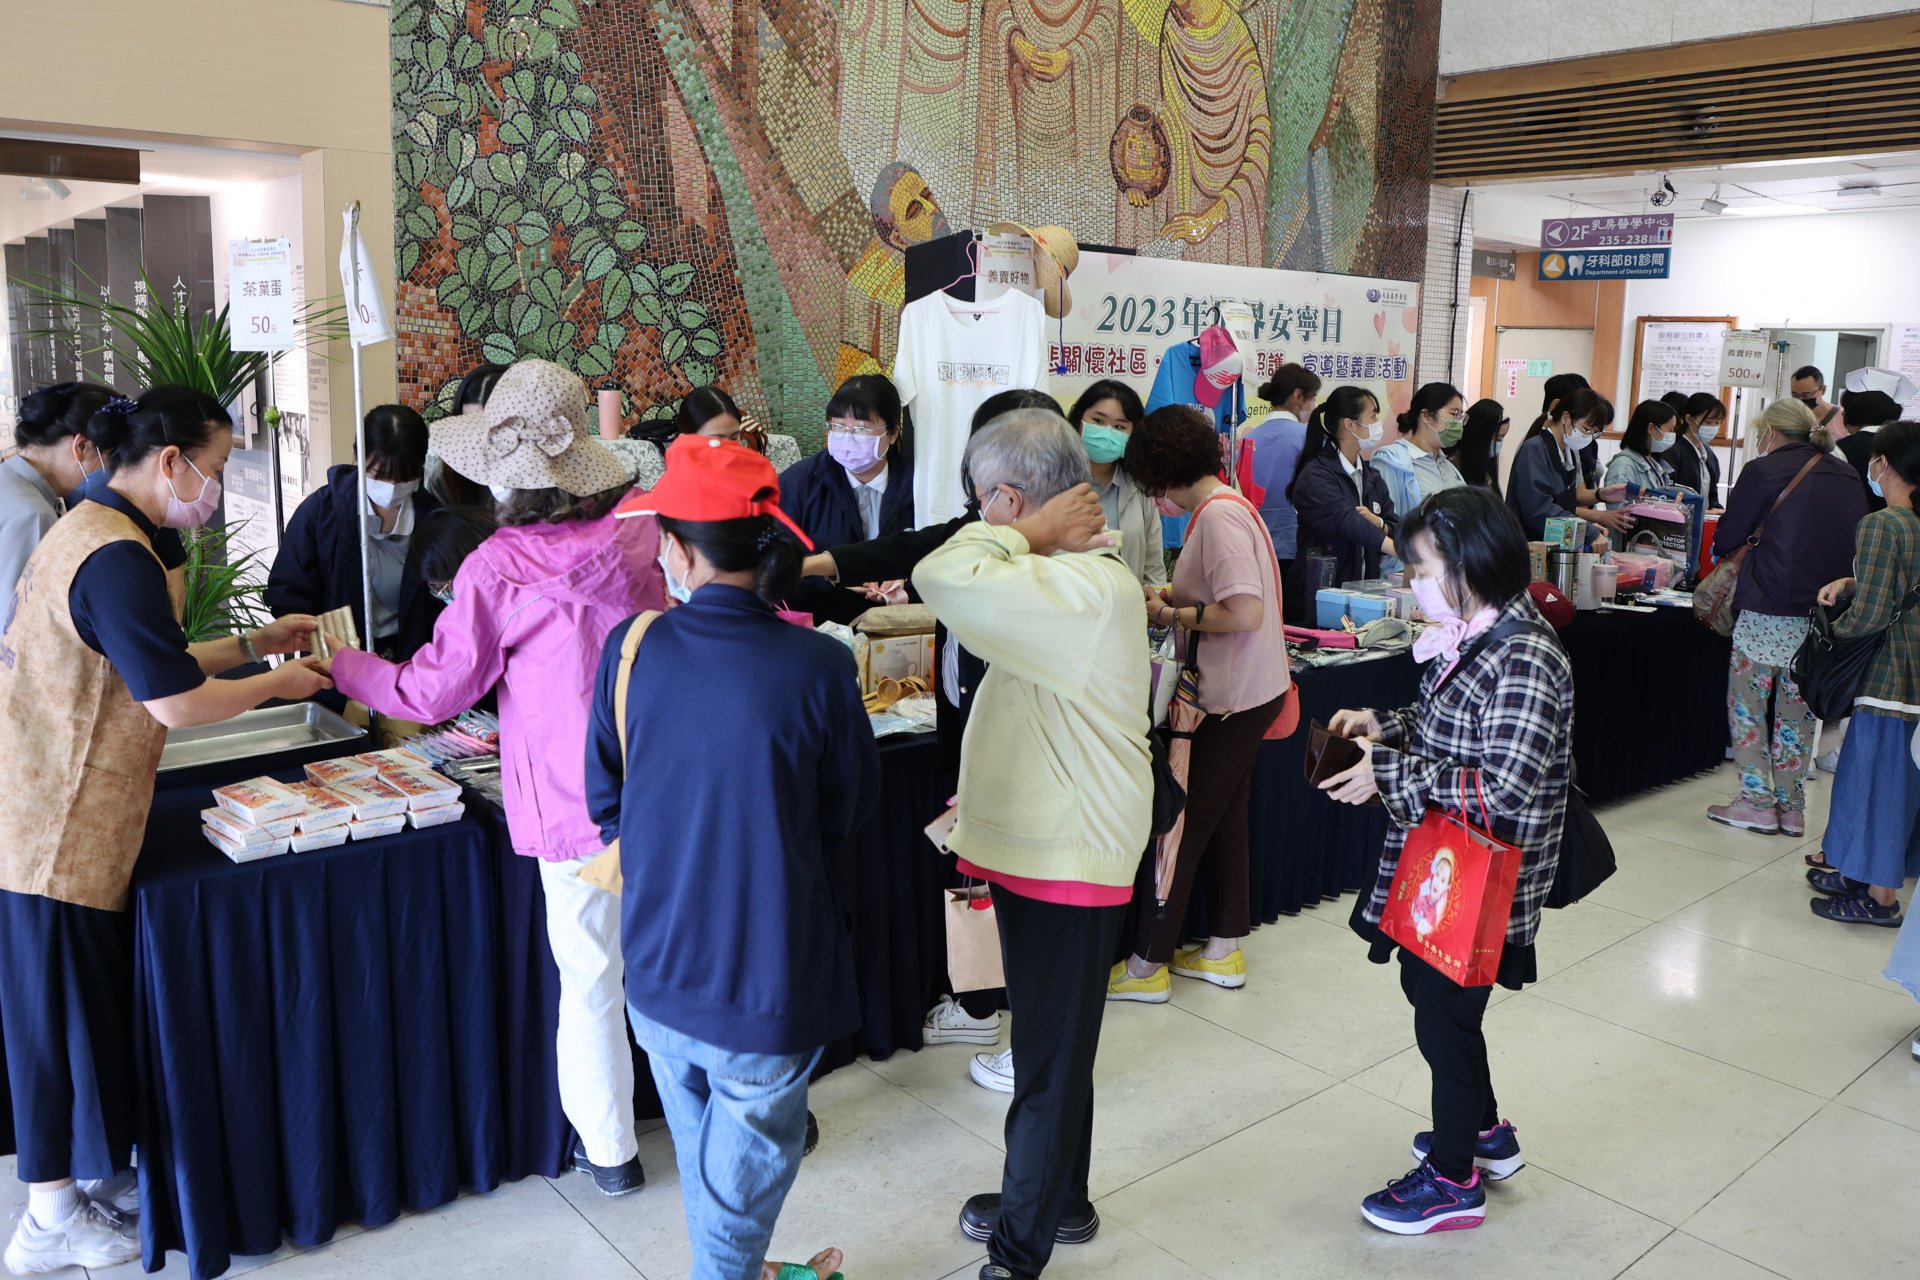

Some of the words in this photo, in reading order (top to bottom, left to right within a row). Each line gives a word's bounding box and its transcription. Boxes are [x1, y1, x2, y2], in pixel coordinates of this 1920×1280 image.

[1592, 216, 1670, 231] 乳房醫學中心
[1571, 225, 1590, 241] 2F
[1587, 253, 1665, 267] 牙科部B1診間
[988, 270, 1030, 285] 義賣好物
[242, 279, 282, 297] 茶葉蛋
[1728, 348, 1762, 359] 義賣好物
